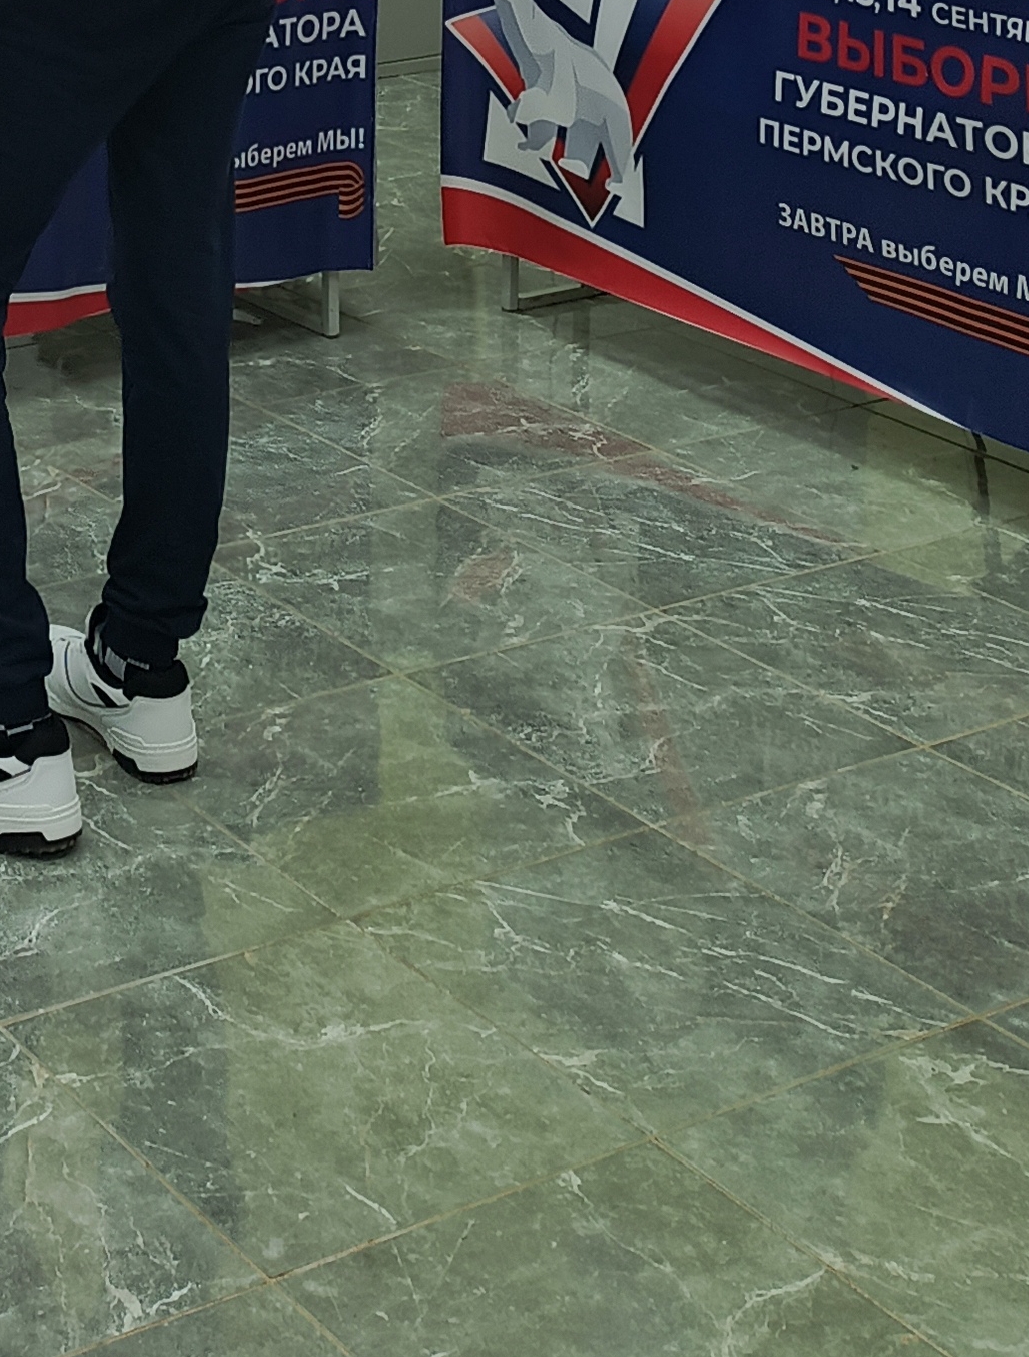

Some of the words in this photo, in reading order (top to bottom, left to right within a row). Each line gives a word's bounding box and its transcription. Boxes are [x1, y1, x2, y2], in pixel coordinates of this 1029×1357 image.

[932, 2, 1029, 43] СЕНТЯ
[295, 55, 367, 87] КРАЯ
[797, 11, 1029, 116] ВЫБОР
[317, 128, 365, 153] МЫ!
[759, 117, 971, 197] ПЕРМСКОГО
[775, 70, 1029, 165] ГУБЕРНАТО
[778, 202, 874, 253] ЗАВТРА
[881, 239, 1009, 295] выберем
